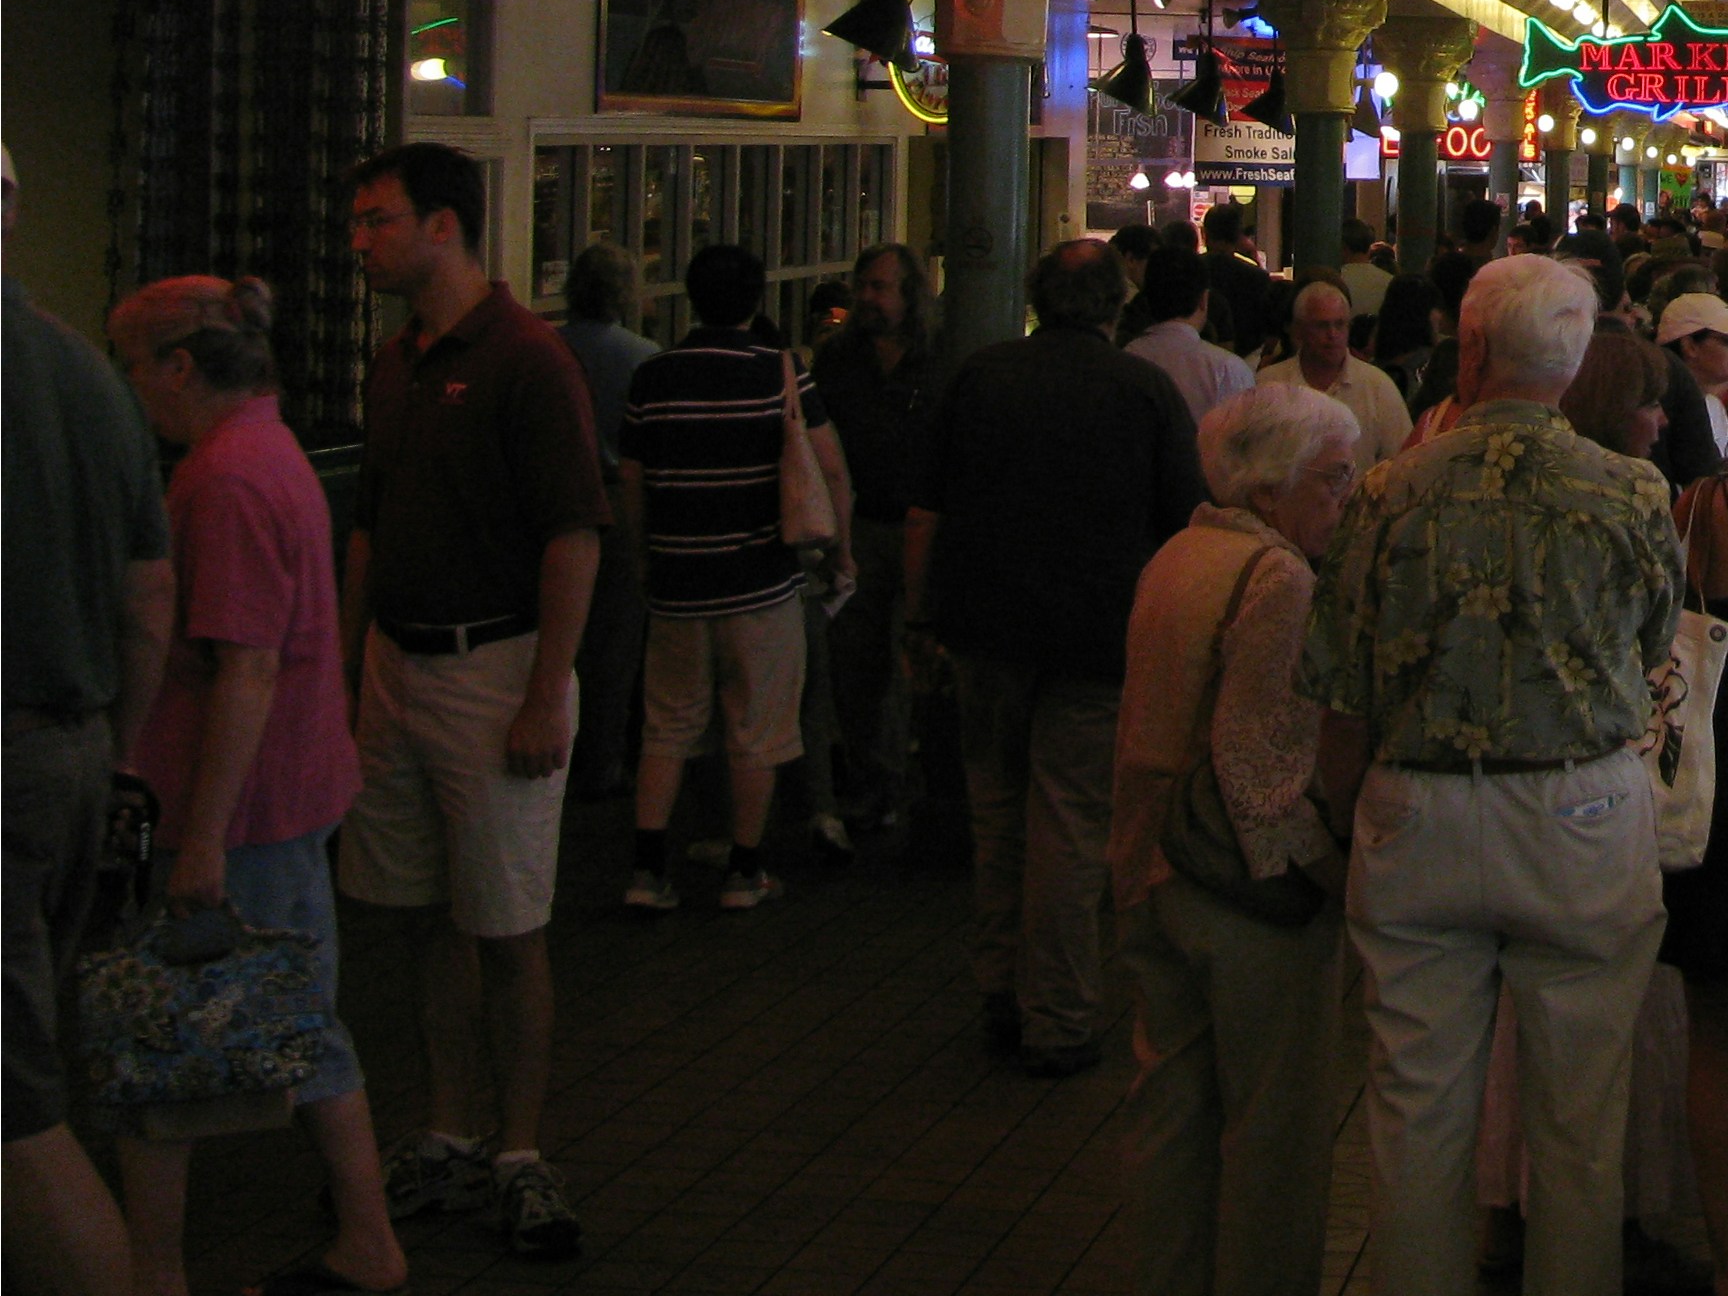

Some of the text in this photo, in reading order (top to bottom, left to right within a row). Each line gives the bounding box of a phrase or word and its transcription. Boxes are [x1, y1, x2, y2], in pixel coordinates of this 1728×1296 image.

[1204, 124, 1294, 140] Fresh Traditio
[1225, 145, 1296, 160] Smoke Sal
[1200, 167, 1295, 182] www.FreshSeaf
